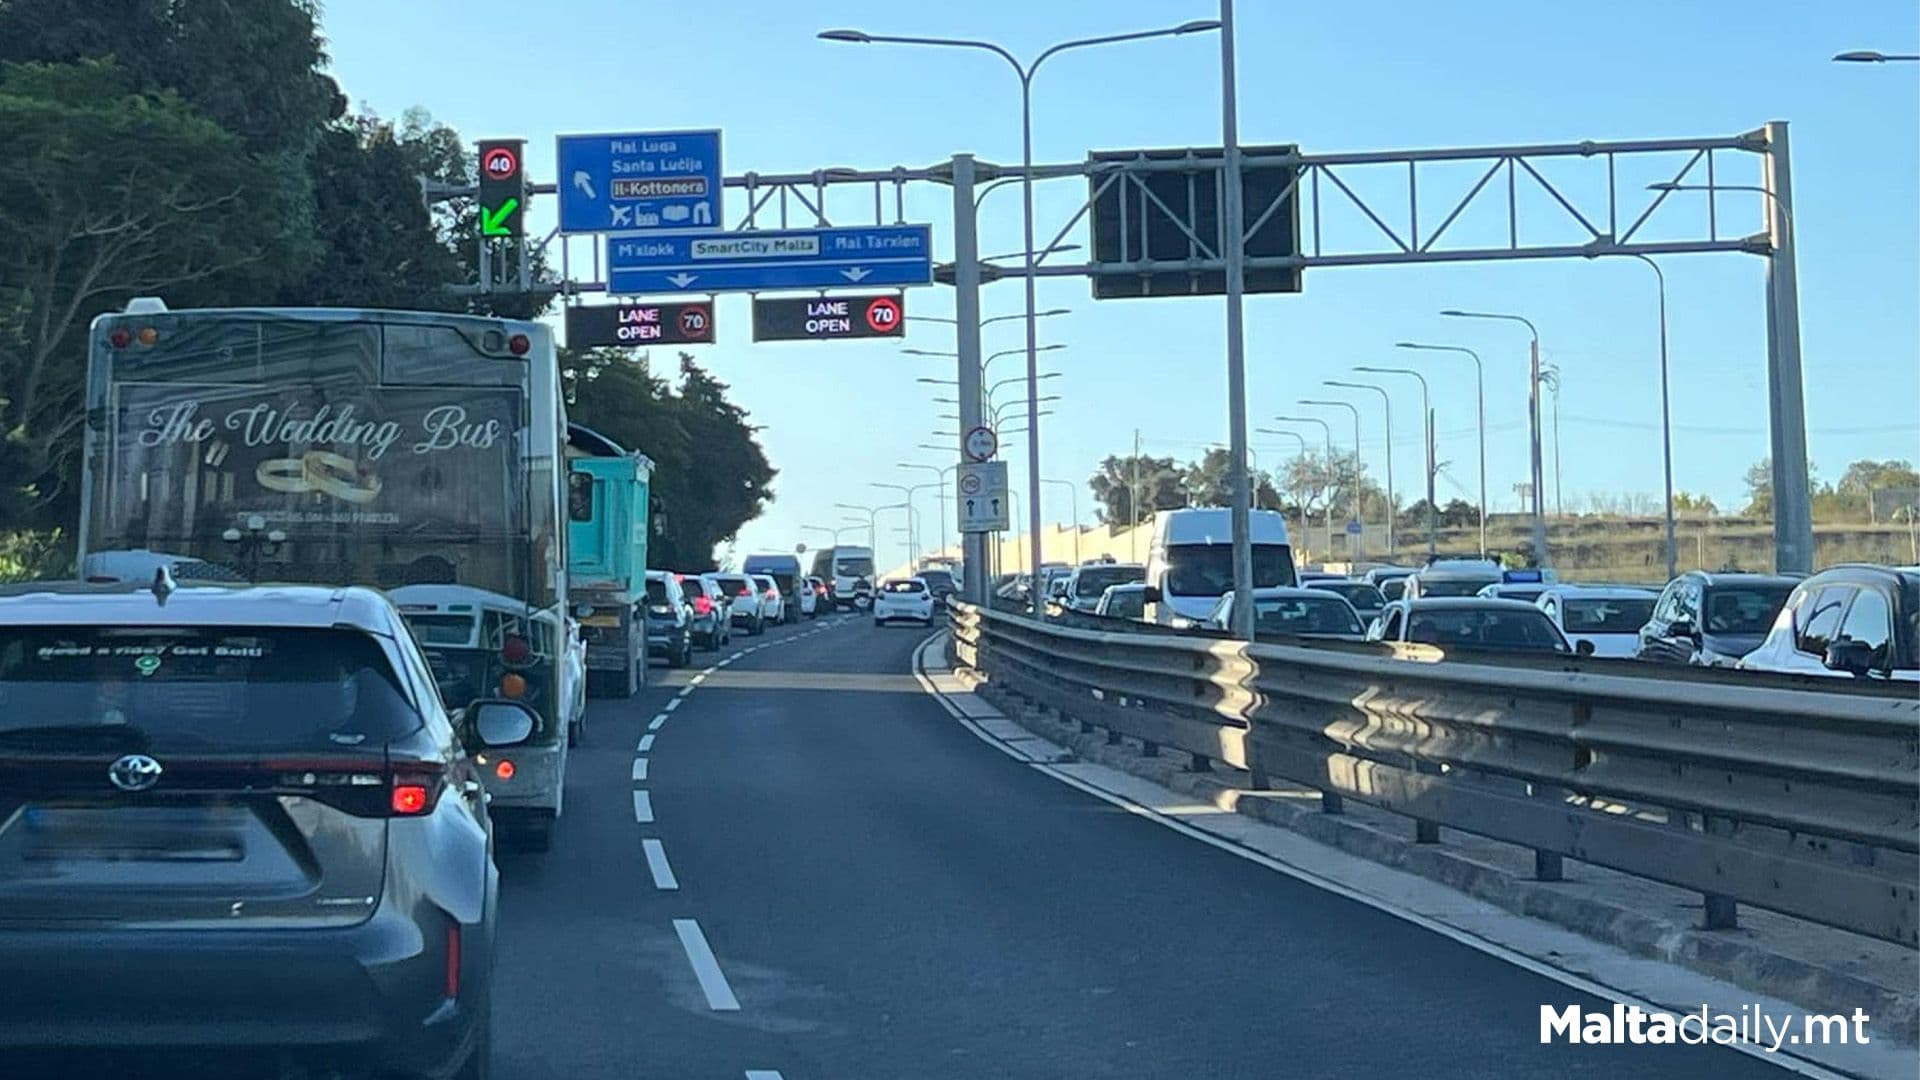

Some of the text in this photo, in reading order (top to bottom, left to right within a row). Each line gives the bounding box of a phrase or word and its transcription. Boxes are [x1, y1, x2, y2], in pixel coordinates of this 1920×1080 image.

[642, 141, 677, 154] Luqa
[490, 158, 511, 172] 40
[612, 160, 655, 173] Santa
[614, 182, 704, 196] Il-Kottonera
[697, 239, 814, 254] SmartCity Malta
[866, 235, 920, 249] Tarxien
[807, 302, 848, 315] LANE
[873, 308, 893, 322] 70
[618, 309, 659, 323] LANE
[683, 315, 704, 329] 70
[617, 325, 661, 339] OPEN
[805, 319, 850, 333] OPEN
[139, 401, 501, 459] The Wedding Bus
